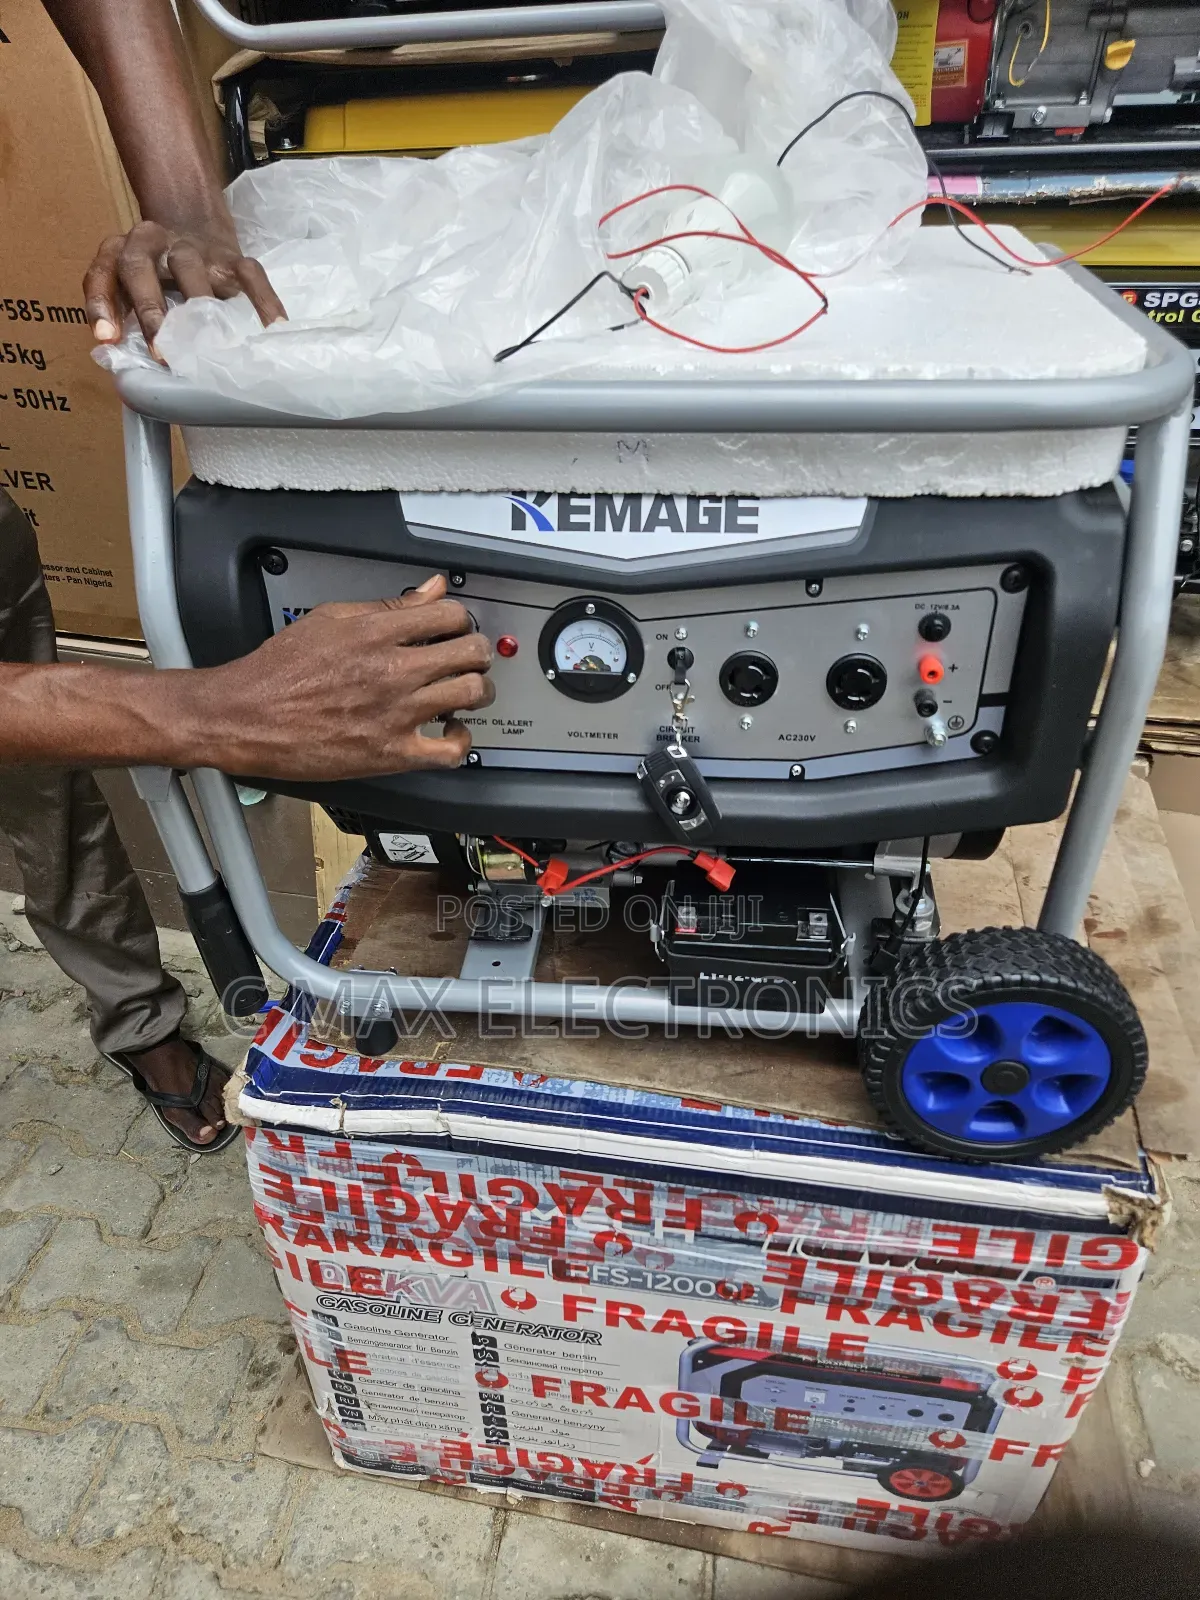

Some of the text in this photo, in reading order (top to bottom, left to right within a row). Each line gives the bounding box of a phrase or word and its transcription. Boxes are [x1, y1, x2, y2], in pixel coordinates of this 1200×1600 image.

[13, 388, 71, 412] 50Hz
[502, 491, 760, 534] KEMAGE
[65, 566, 80, 574] and
[67, 575, 83, 585] Pan
[656, 633, 669, 641] ON
[491, 718, 533, 728] OIL ALERT
[502, 728, 525, 736] LAMP
[567, 730, 619, 740] VOLTMETER
[777, 733, 817, 743] AC230V
[316, 1294, 603, 1346] GASOLINE GENERATOR
[561, 1293, 869, 1362] FRAGILE
[780, 1289, 1110, 1359] FRAGILE
[343, 1322, 450, 1341] Gasoline Generator
[346, 1335, 412, 1350] Benzingenerator
[430, 1346, 460, 1356] Benzin
[504, 1342, 598, 1361] Generator bensin
[358, 1376, 461, 1397] Gerador de gasolina
[361, 1388, 405, 1401] Generator
[343, 1409, 359, 1418] VN
[530, 1373, 811, 1436] FRAGILE
[511, 1410, 606, 1431] Generator benzyny
